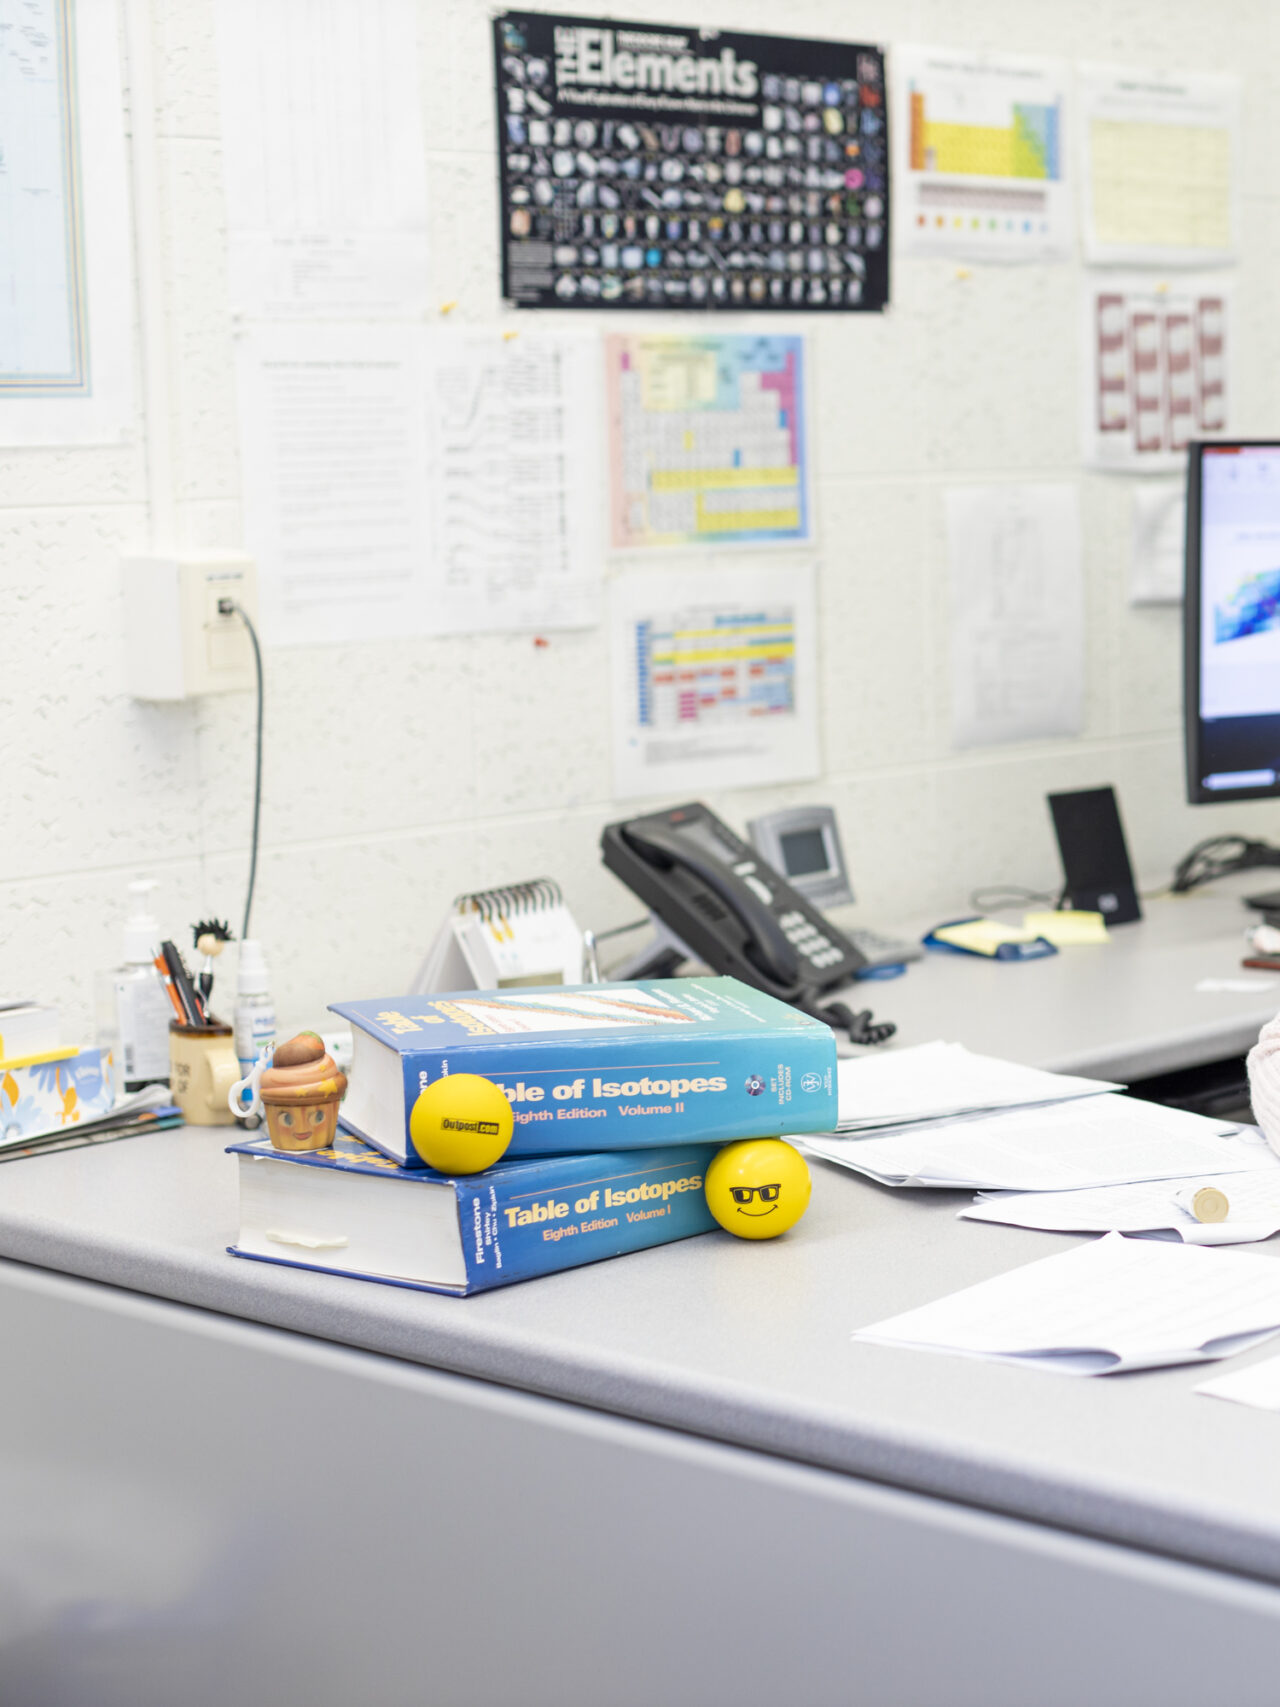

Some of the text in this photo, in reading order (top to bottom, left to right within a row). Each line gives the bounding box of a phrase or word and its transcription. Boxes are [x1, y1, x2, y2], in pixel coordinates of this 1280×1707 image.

[554, 26, 578, 86] THE
[577, 27, 759, 97] Elements
[496, 1077, 728, 1103] ble of Isotopes
[770, 1077, 778, 1093] SET
[777, 1063, 785, 1105] INCLUDES
[556, 1108, 607, 1120] Edition
[618, 1104, 673, 1116] Volume
[675, 1102, 685, 1113] II
[488, 1185, 497, 1213] Zipkin
[504, 1175, 703, 1228] Table of Isotopes
[472, 1197, 485, 1265] Firestone
[483, 1211, 493, 1246] Shirley
[543, 1225, 579, 1242] Eighth
[580, 1217, 618, 1234] Edition
[626, 1205, 666, 1224] Volume
[493, 1242, 503, 1269] Baglin
